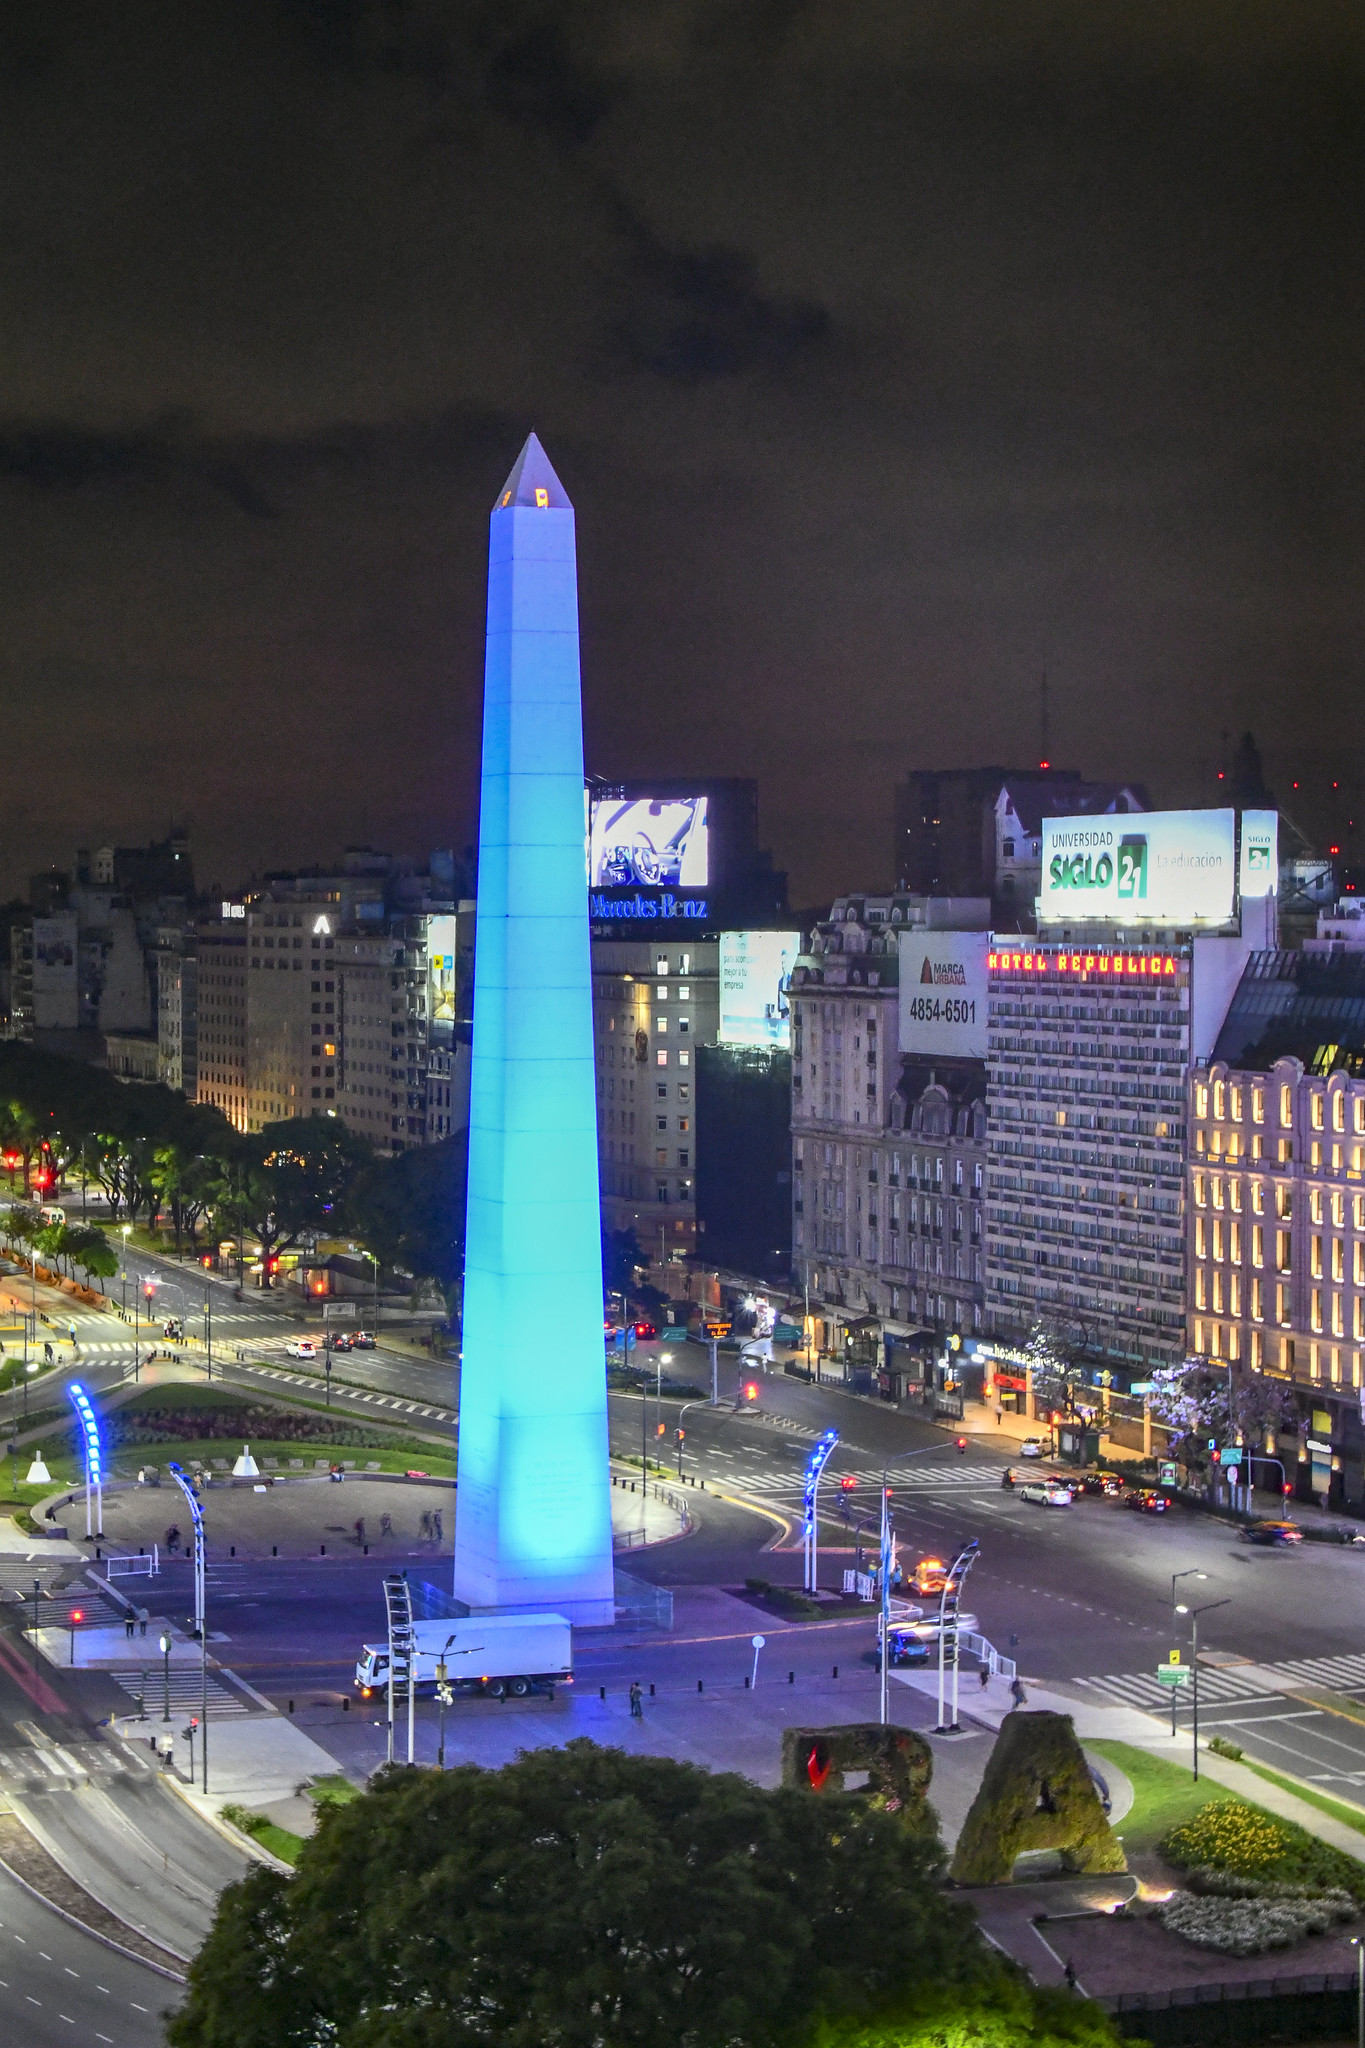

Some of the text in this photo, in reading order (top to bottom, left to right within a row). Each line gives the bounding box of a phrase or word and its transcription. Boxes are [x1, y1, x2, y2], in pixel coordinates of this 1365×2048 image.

[1052, 831, 1113, 848] UNIVERSIDAD
[1157, 851, 1222, 868] La educación
[1250, 850, 1269, 870] 21
[1049, 852, 1142, 898] SIGLO 21
[590, 893, 709, 919] Mercedes-Benz
[933, 963, 965, 975] MARCA
[988, 954, 1175, 974] HOTEL REPUBLICA
[724, 981, 744, 991] empresa
[933, 974, 967, 986] URBANA
[910, 997, 976, 1024] 4854-6501
